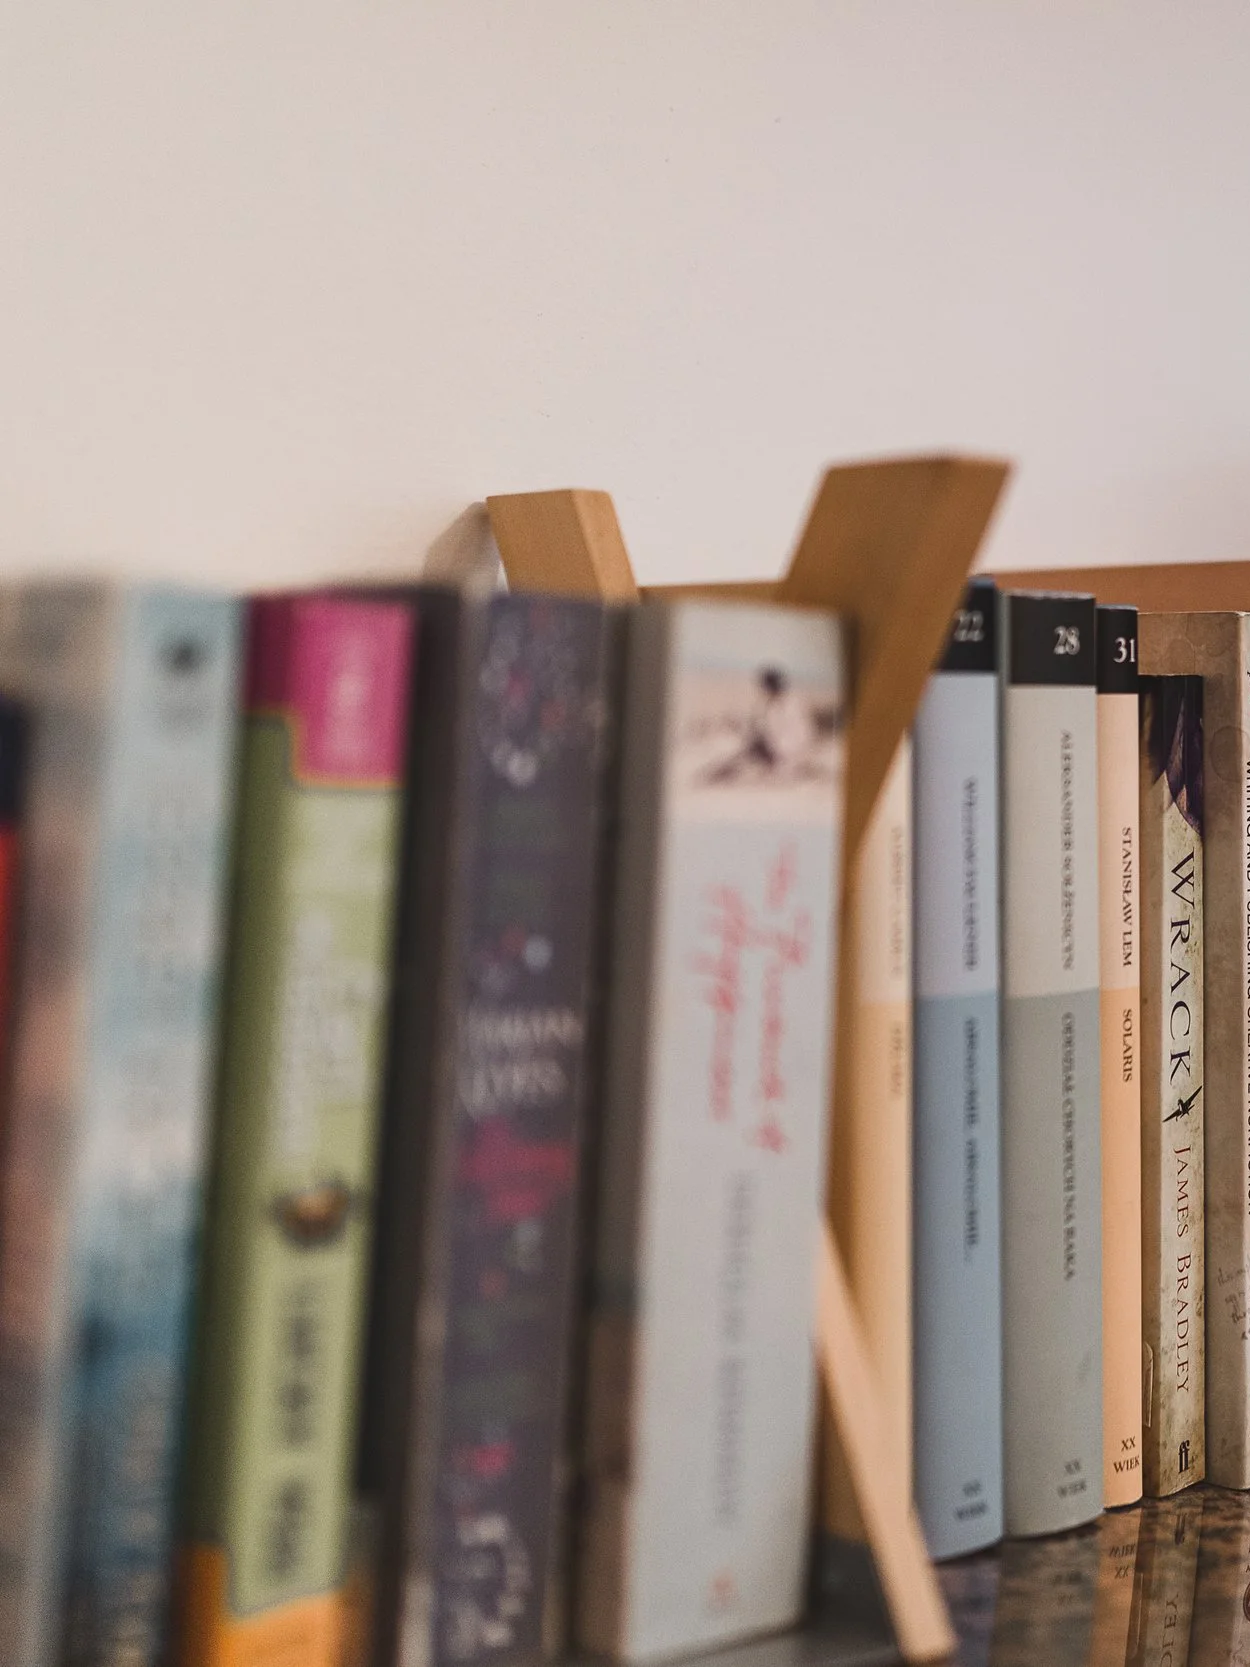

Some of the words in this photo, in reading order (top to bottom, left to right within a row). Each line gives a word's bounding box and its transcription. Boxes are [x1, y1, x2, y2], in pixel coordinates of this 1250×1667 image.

[953, 609, 985, 643] 22
[1054, 626, 1080, 655] 28
[1114, 637, 1136, 663] 31
[1122, 932, 1133, 967] LEM
[1170, 847, 1195, 1085] WRACK
[1122, 1008, 1133, 1083] SOLARIS
[1174, 1145, 1192, 1238] JAMES
[1176, 1254, 1192, 1393] BRADLEY
[1121, 1436, 1136, 1452] XX
[1178, 1441, 1191, 1475] ff
[1113, 1456, 1140, 1474] WIEK
